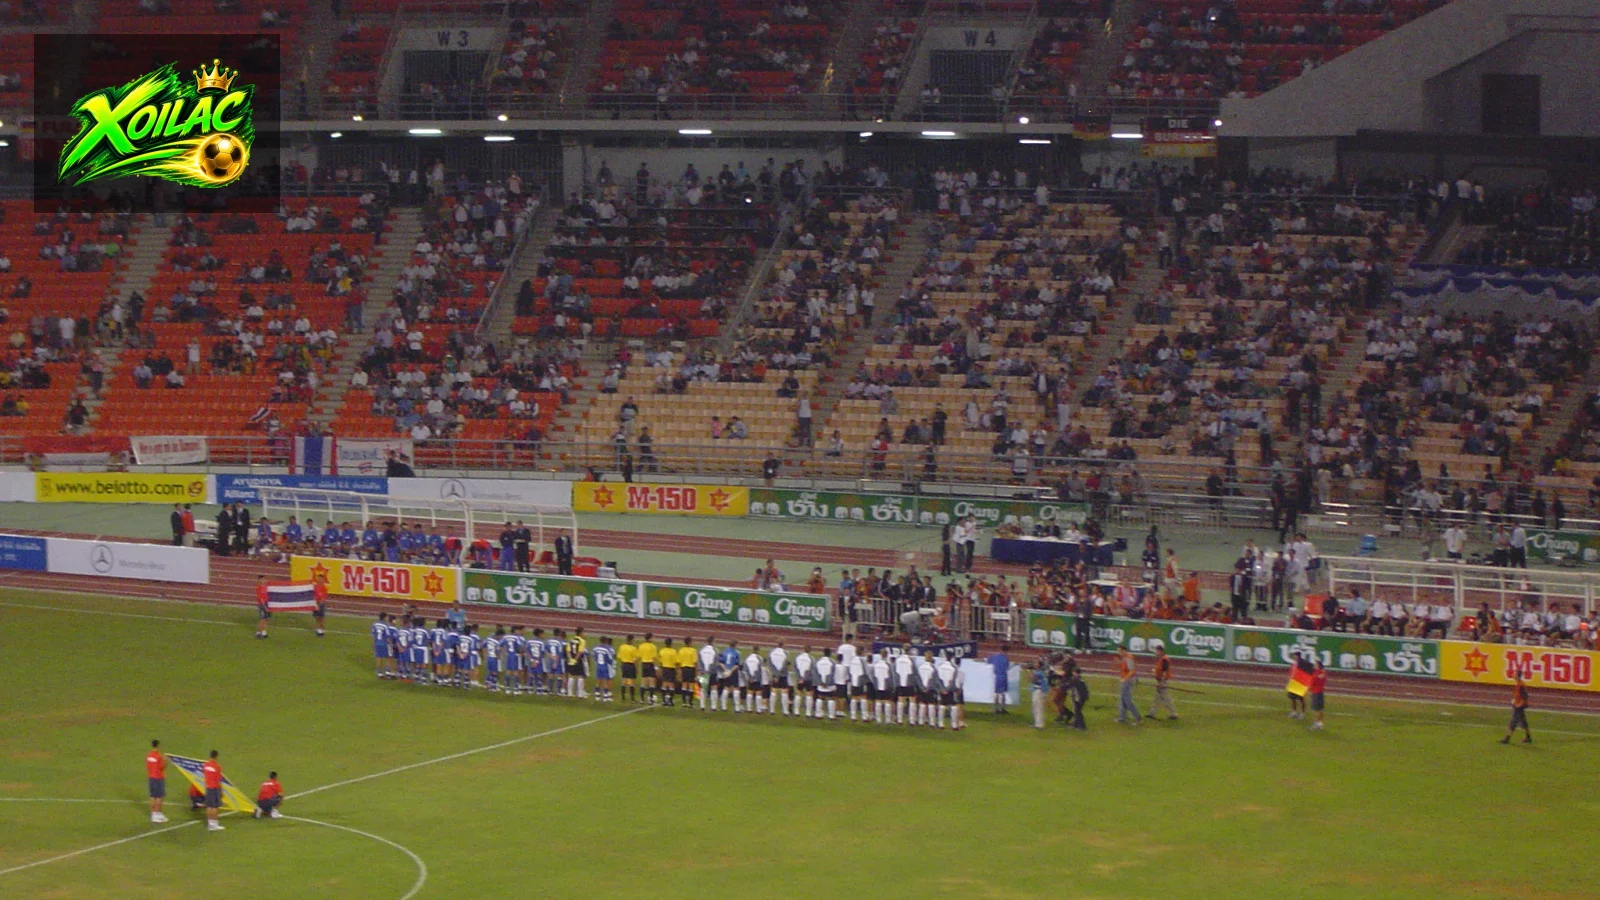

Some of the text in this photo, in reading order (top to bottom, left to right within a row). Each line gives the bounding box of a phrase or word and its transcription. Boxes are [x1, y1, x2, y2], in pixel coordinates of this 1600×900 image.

[437, 30, 469, 47] W 3
[963, 30, 996, 46] W 4
[628, 486, 697, 511] M-150
[954, 501, 1000, 520] Chang
[342, 564, 411, 595] M-150
[684, 591, 733, 614] Chang
[775, 598, 825, 621] Chang
[1171, 626, 1225, 651] Chang
[1505, 650, 1592, 685] M-150
